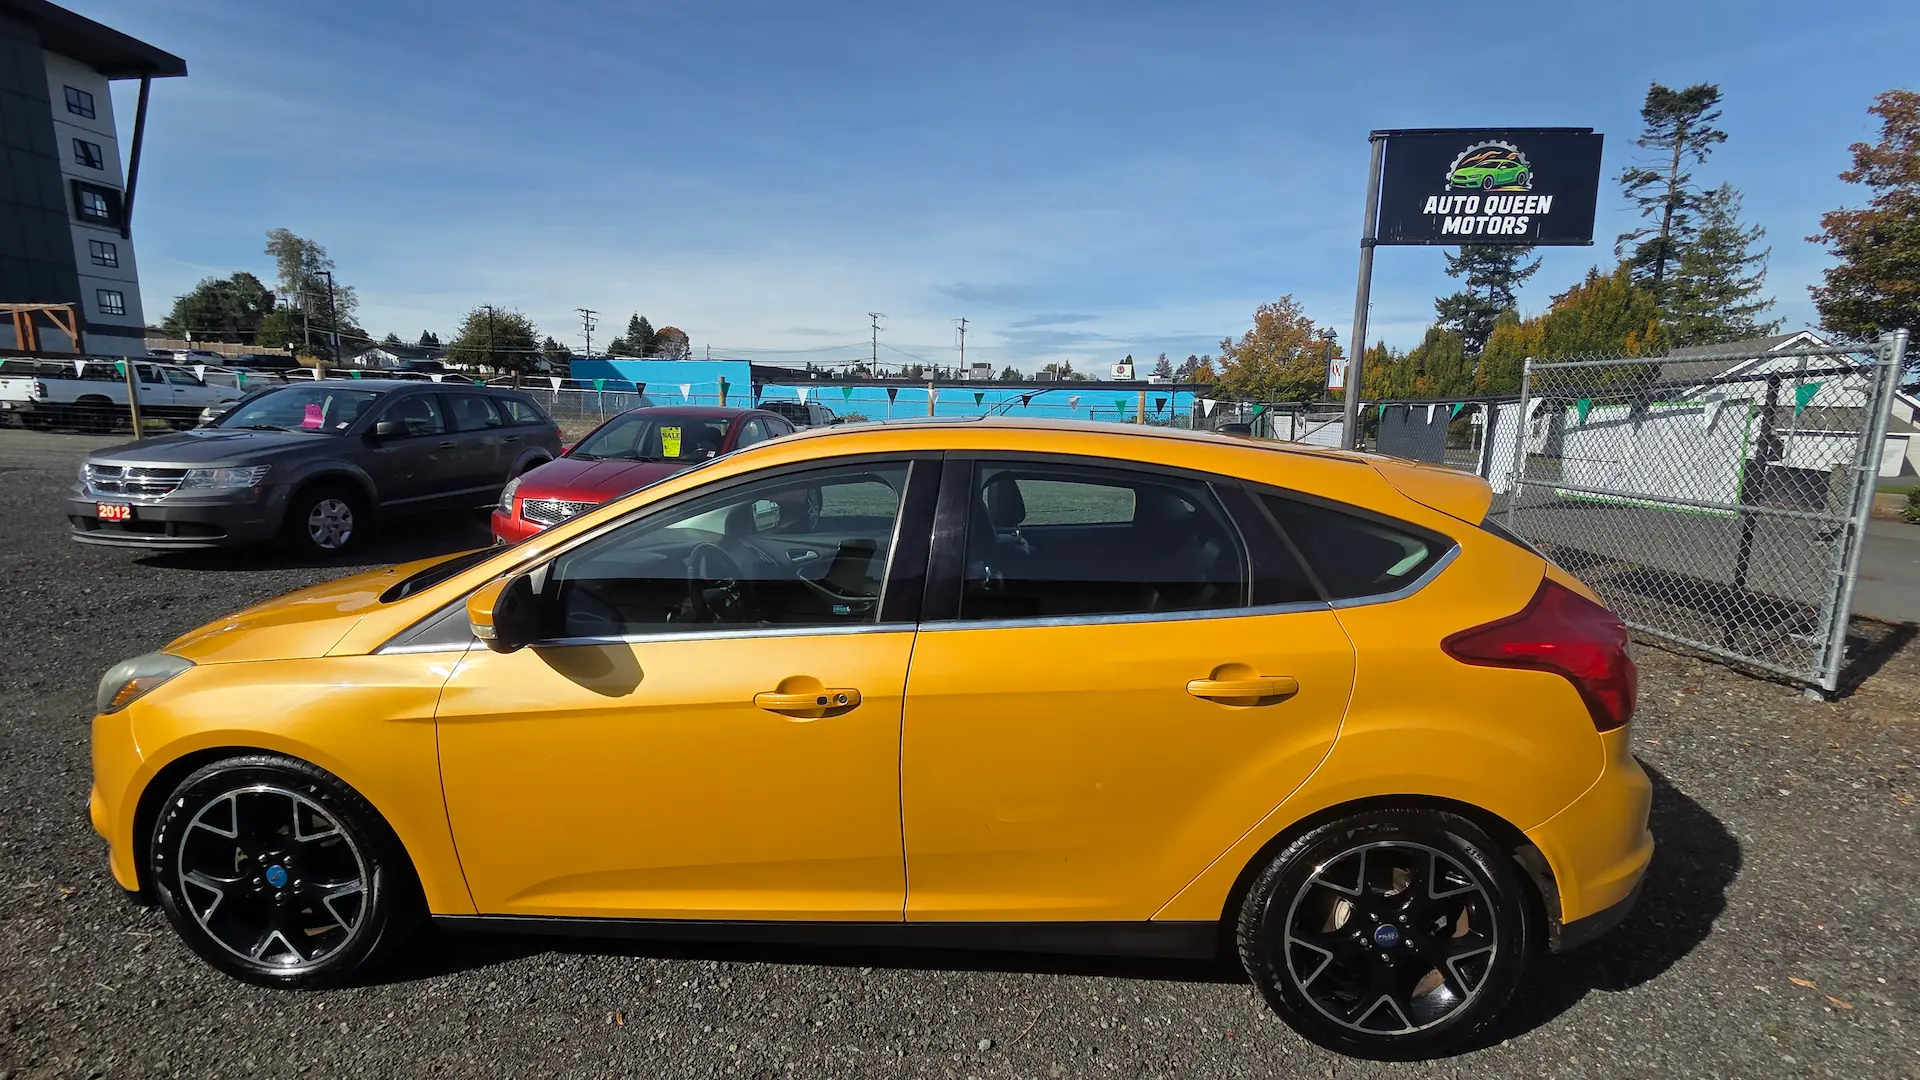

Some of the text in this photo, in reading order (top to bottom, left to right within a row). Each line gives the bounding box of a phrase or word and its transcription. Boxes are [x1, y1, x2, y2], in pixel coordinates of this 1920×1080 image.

[1423, 195, 1553, 215] AUTO QUEEN
[1441, 216, 1529, 234] MOTORS
[98, 505, 131, 518] 2012
